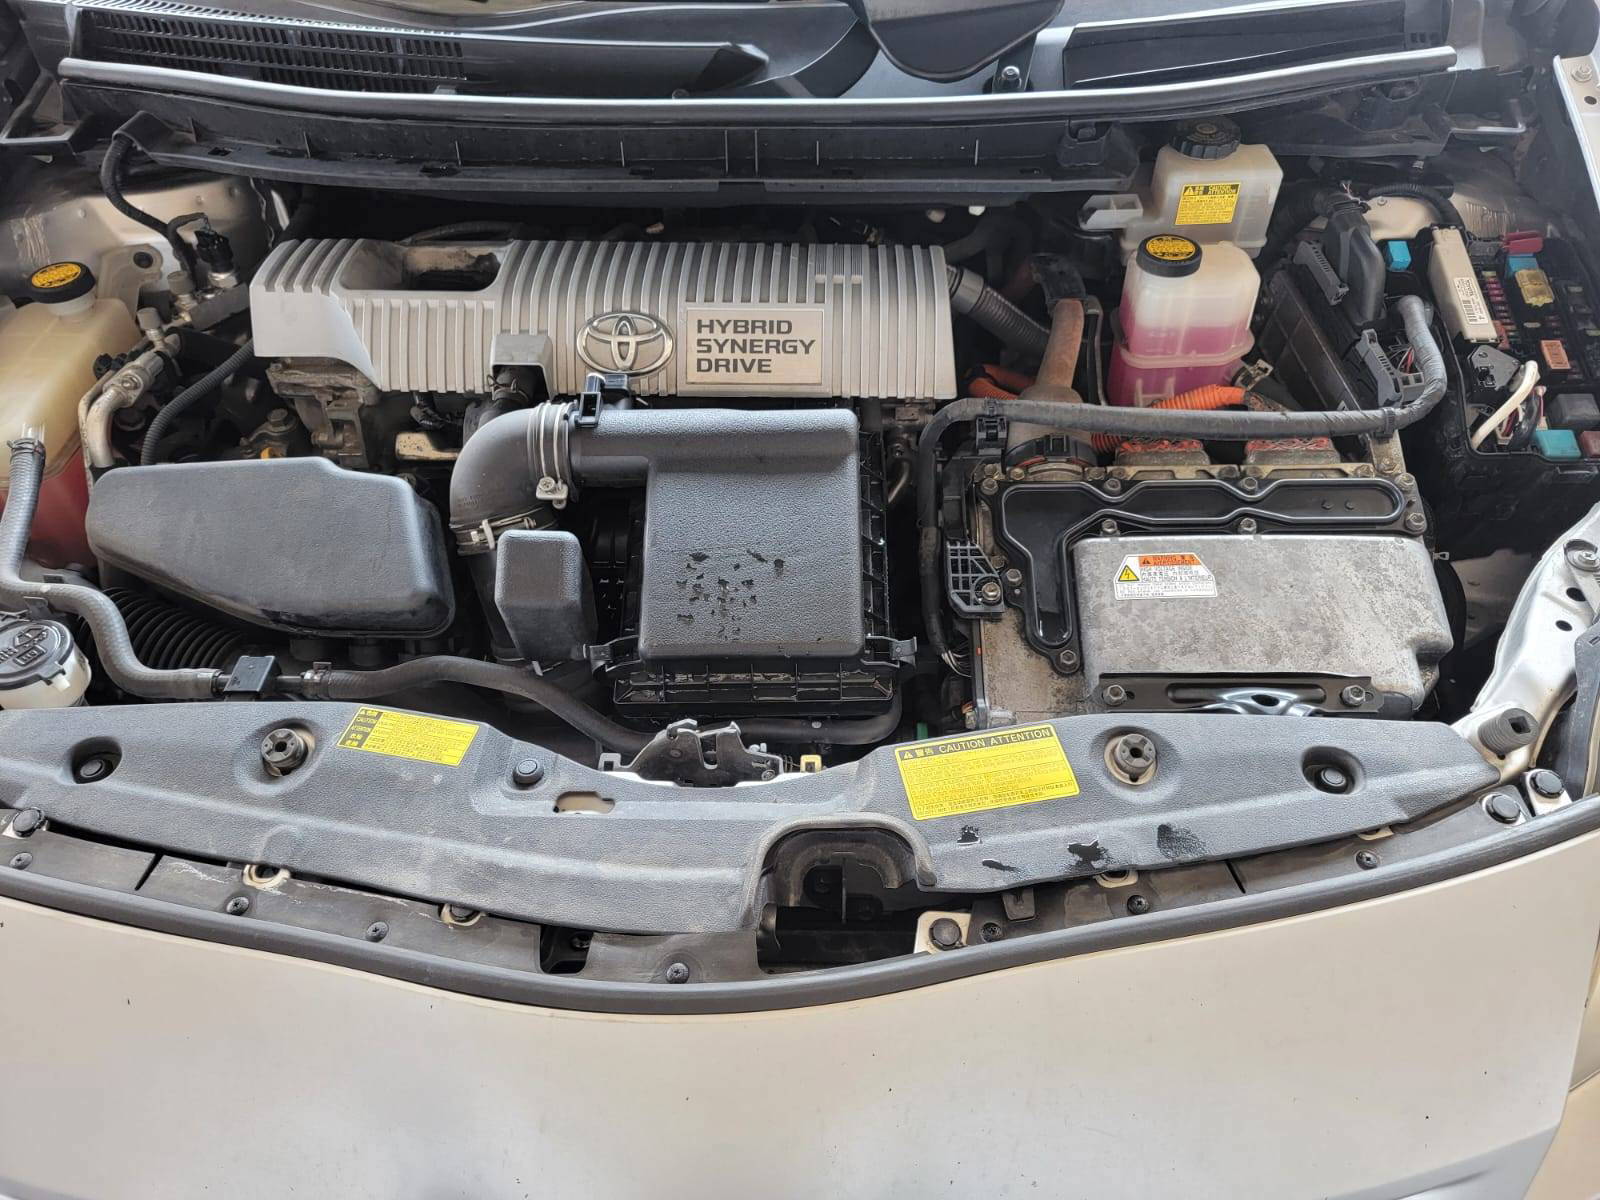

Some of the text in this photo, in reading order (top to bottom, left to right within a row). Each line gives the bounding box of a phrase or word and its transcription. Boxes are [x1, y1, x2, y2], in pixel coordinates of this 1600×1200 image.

[697, 319, 792, 334] HYBRID
[696, 338, 816, 354] SYNERGY
[696, 358, 772, 373] DRIVE
[938, 737, 985, 753] CAUTION
[990, 728, 1050, 746] ATTENTION
